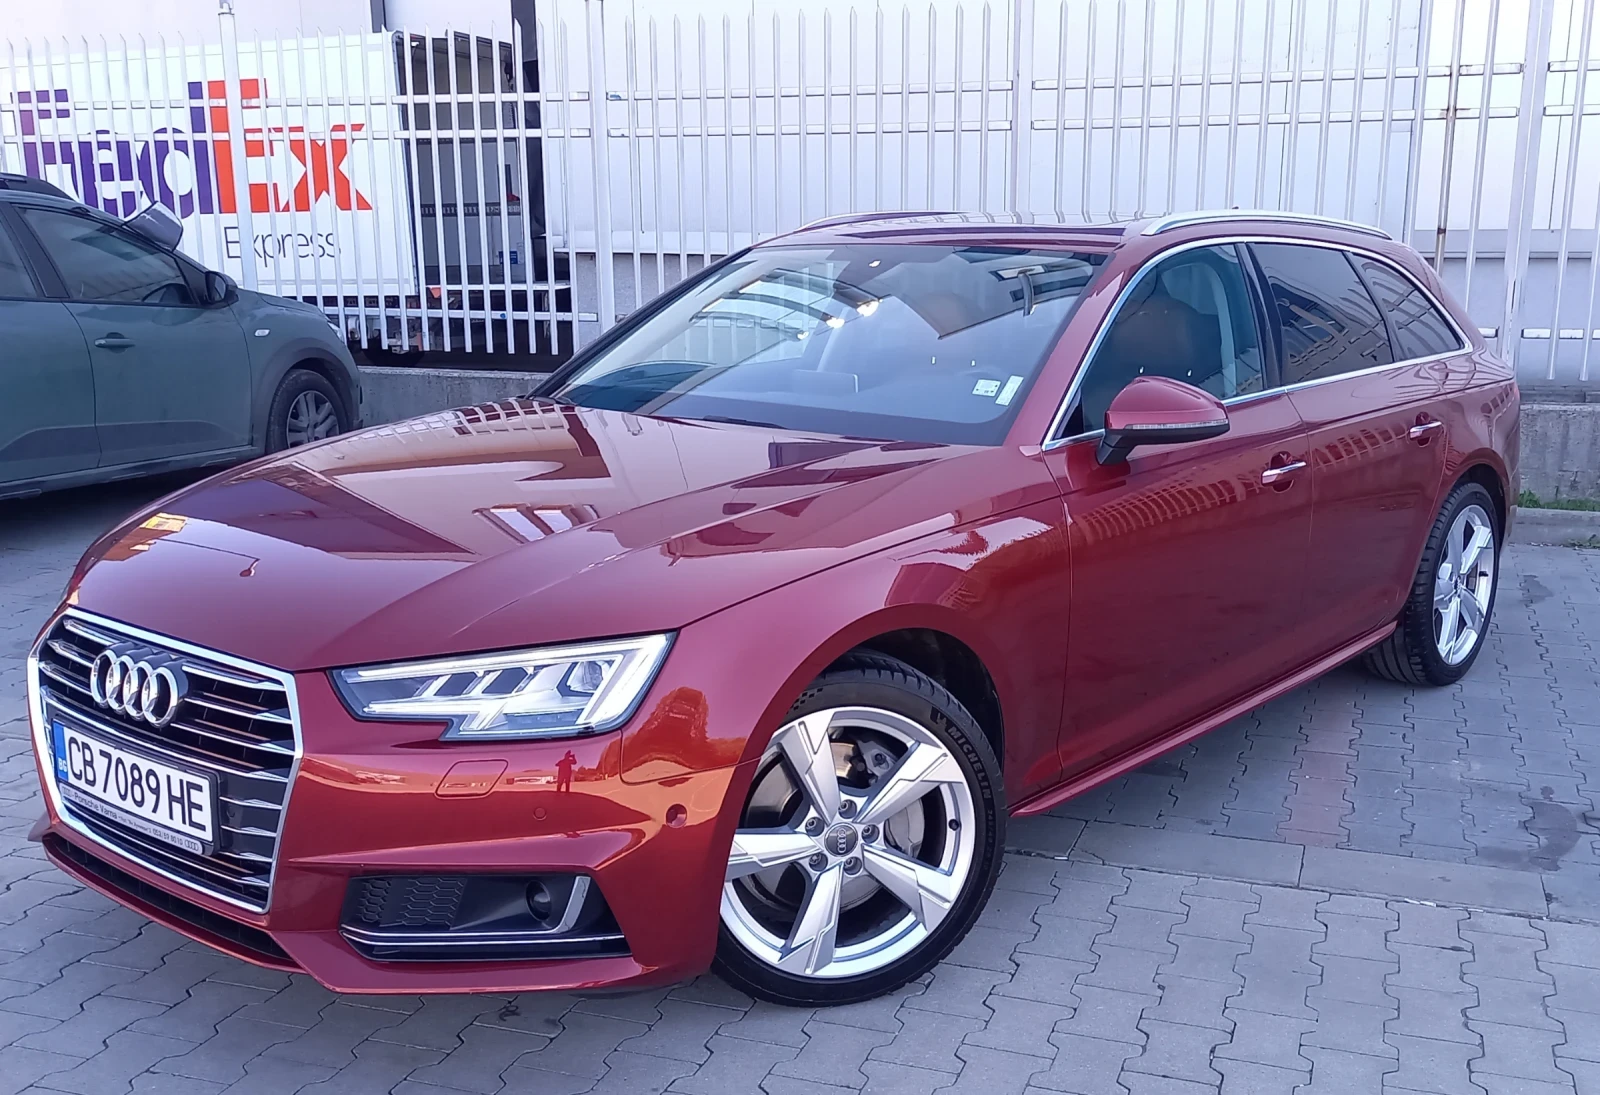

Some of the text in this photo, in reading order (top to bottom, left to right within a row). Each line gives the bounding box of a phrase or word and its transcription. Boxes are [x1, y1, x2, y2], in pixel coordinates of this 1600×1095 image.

[10, 77, 373, 219] FedEx
[224, 226, 341, 268] Express
[58, 756, 68, 773] BG
[947, 725, 992, 799] MICHELIN
